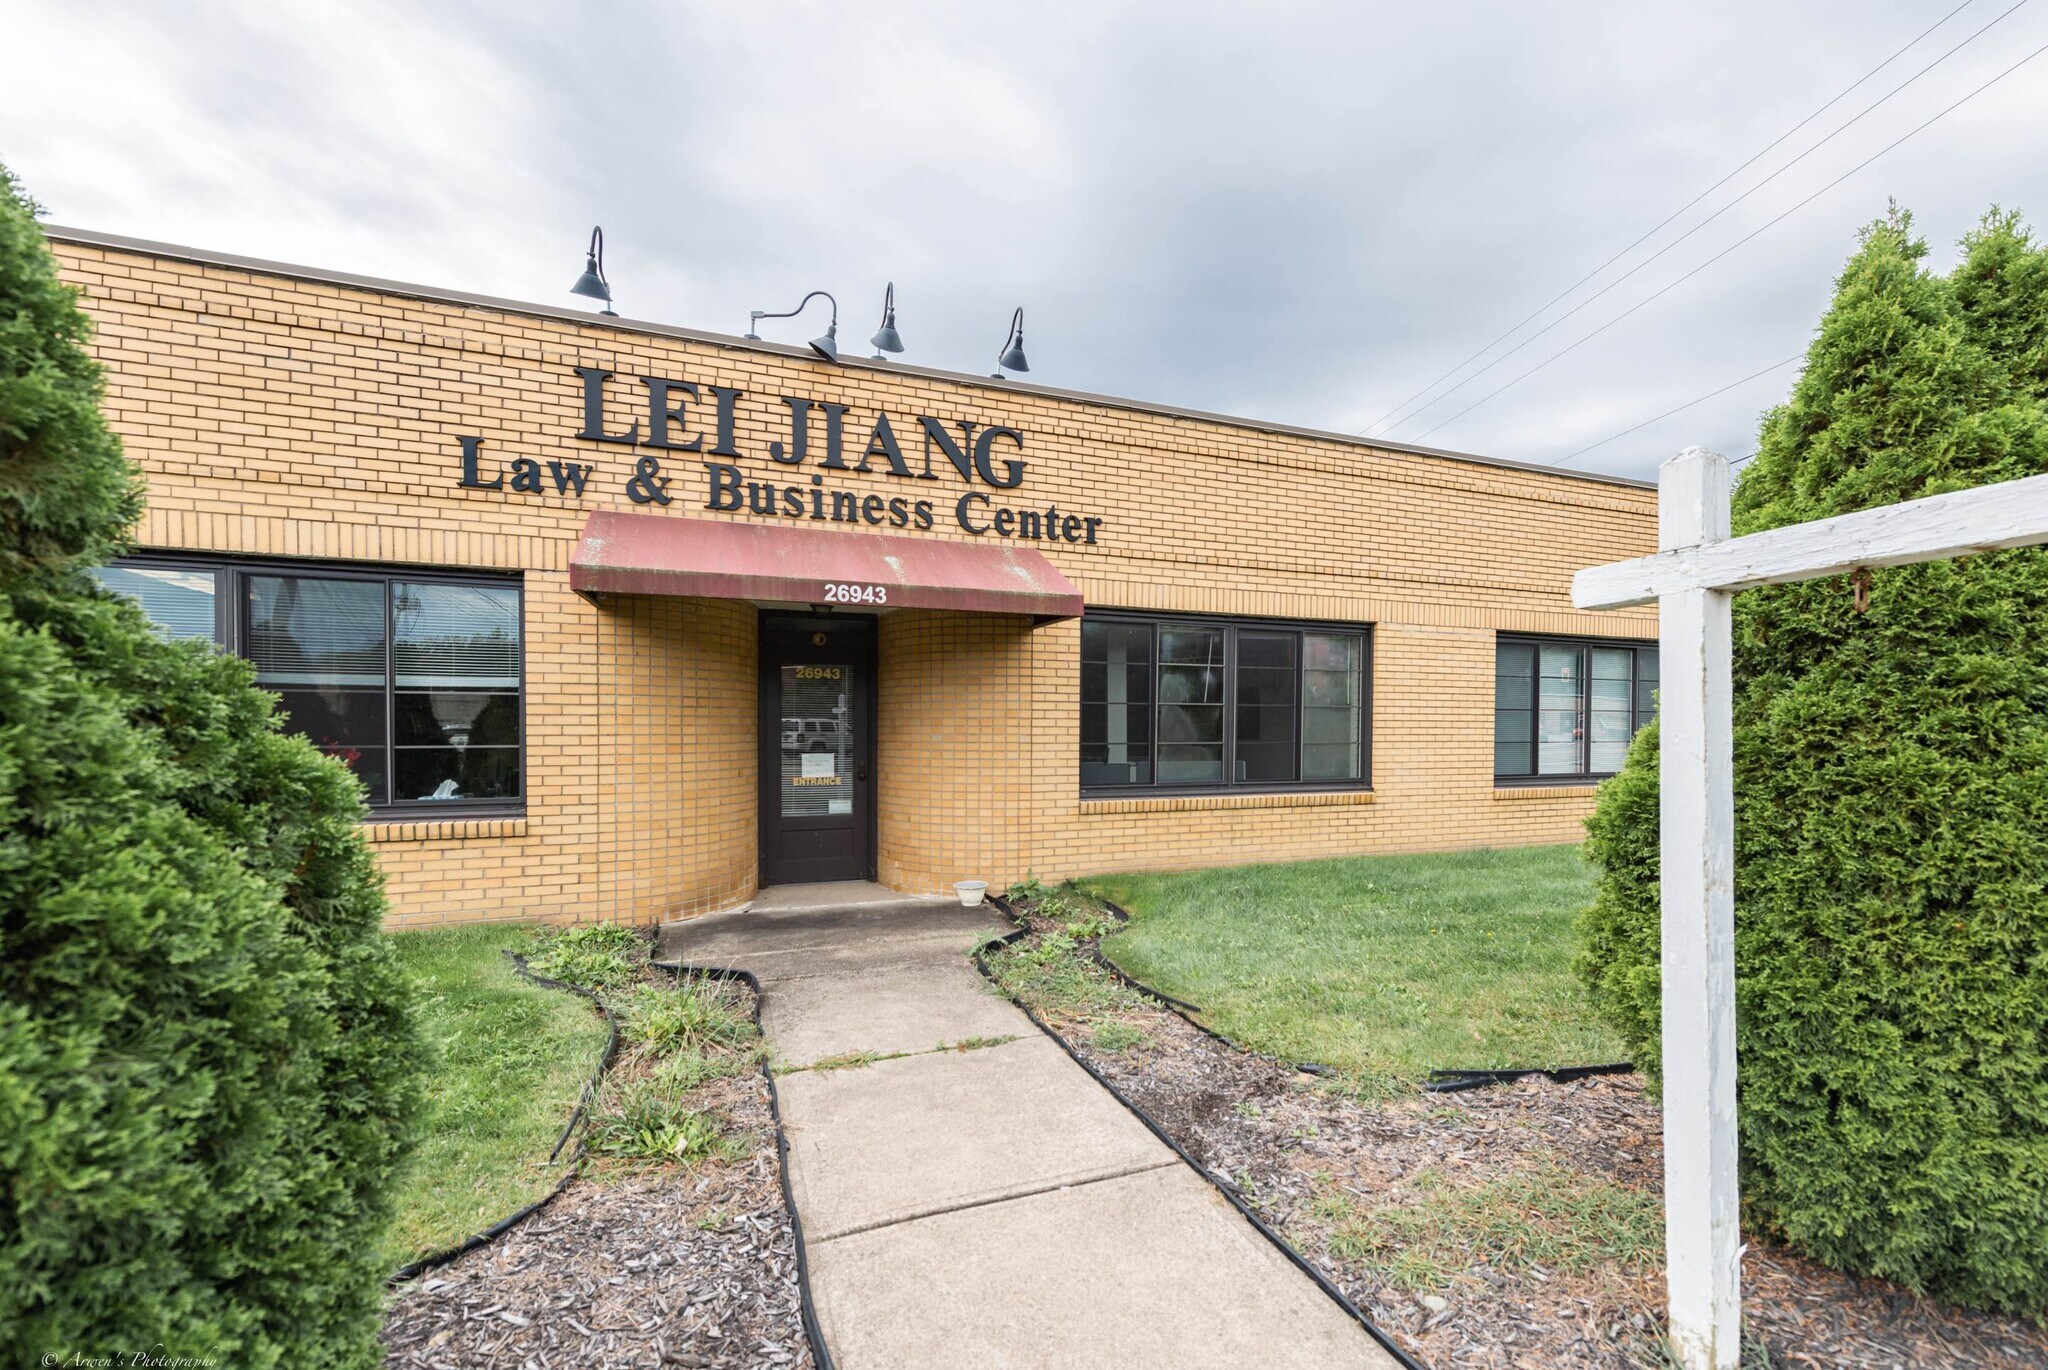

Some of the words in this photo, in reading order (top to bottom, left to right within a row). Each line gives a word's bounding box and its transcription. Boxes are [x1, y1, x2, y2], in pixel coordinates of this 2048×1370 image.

[573, 366, 744, 458] LEI
[769, 396, 1029, 488] JIANG
[455, 435, 594, 497] Law
[625, 456, 674, 505] &
[704, 462, 935, 530] Business
[955, 491, 1103, 545] Center
[823, 583, 888, 605] 26943
[795, 668, 841, 680] 26943
[793, 776, 842, 786] ENTRANCE
